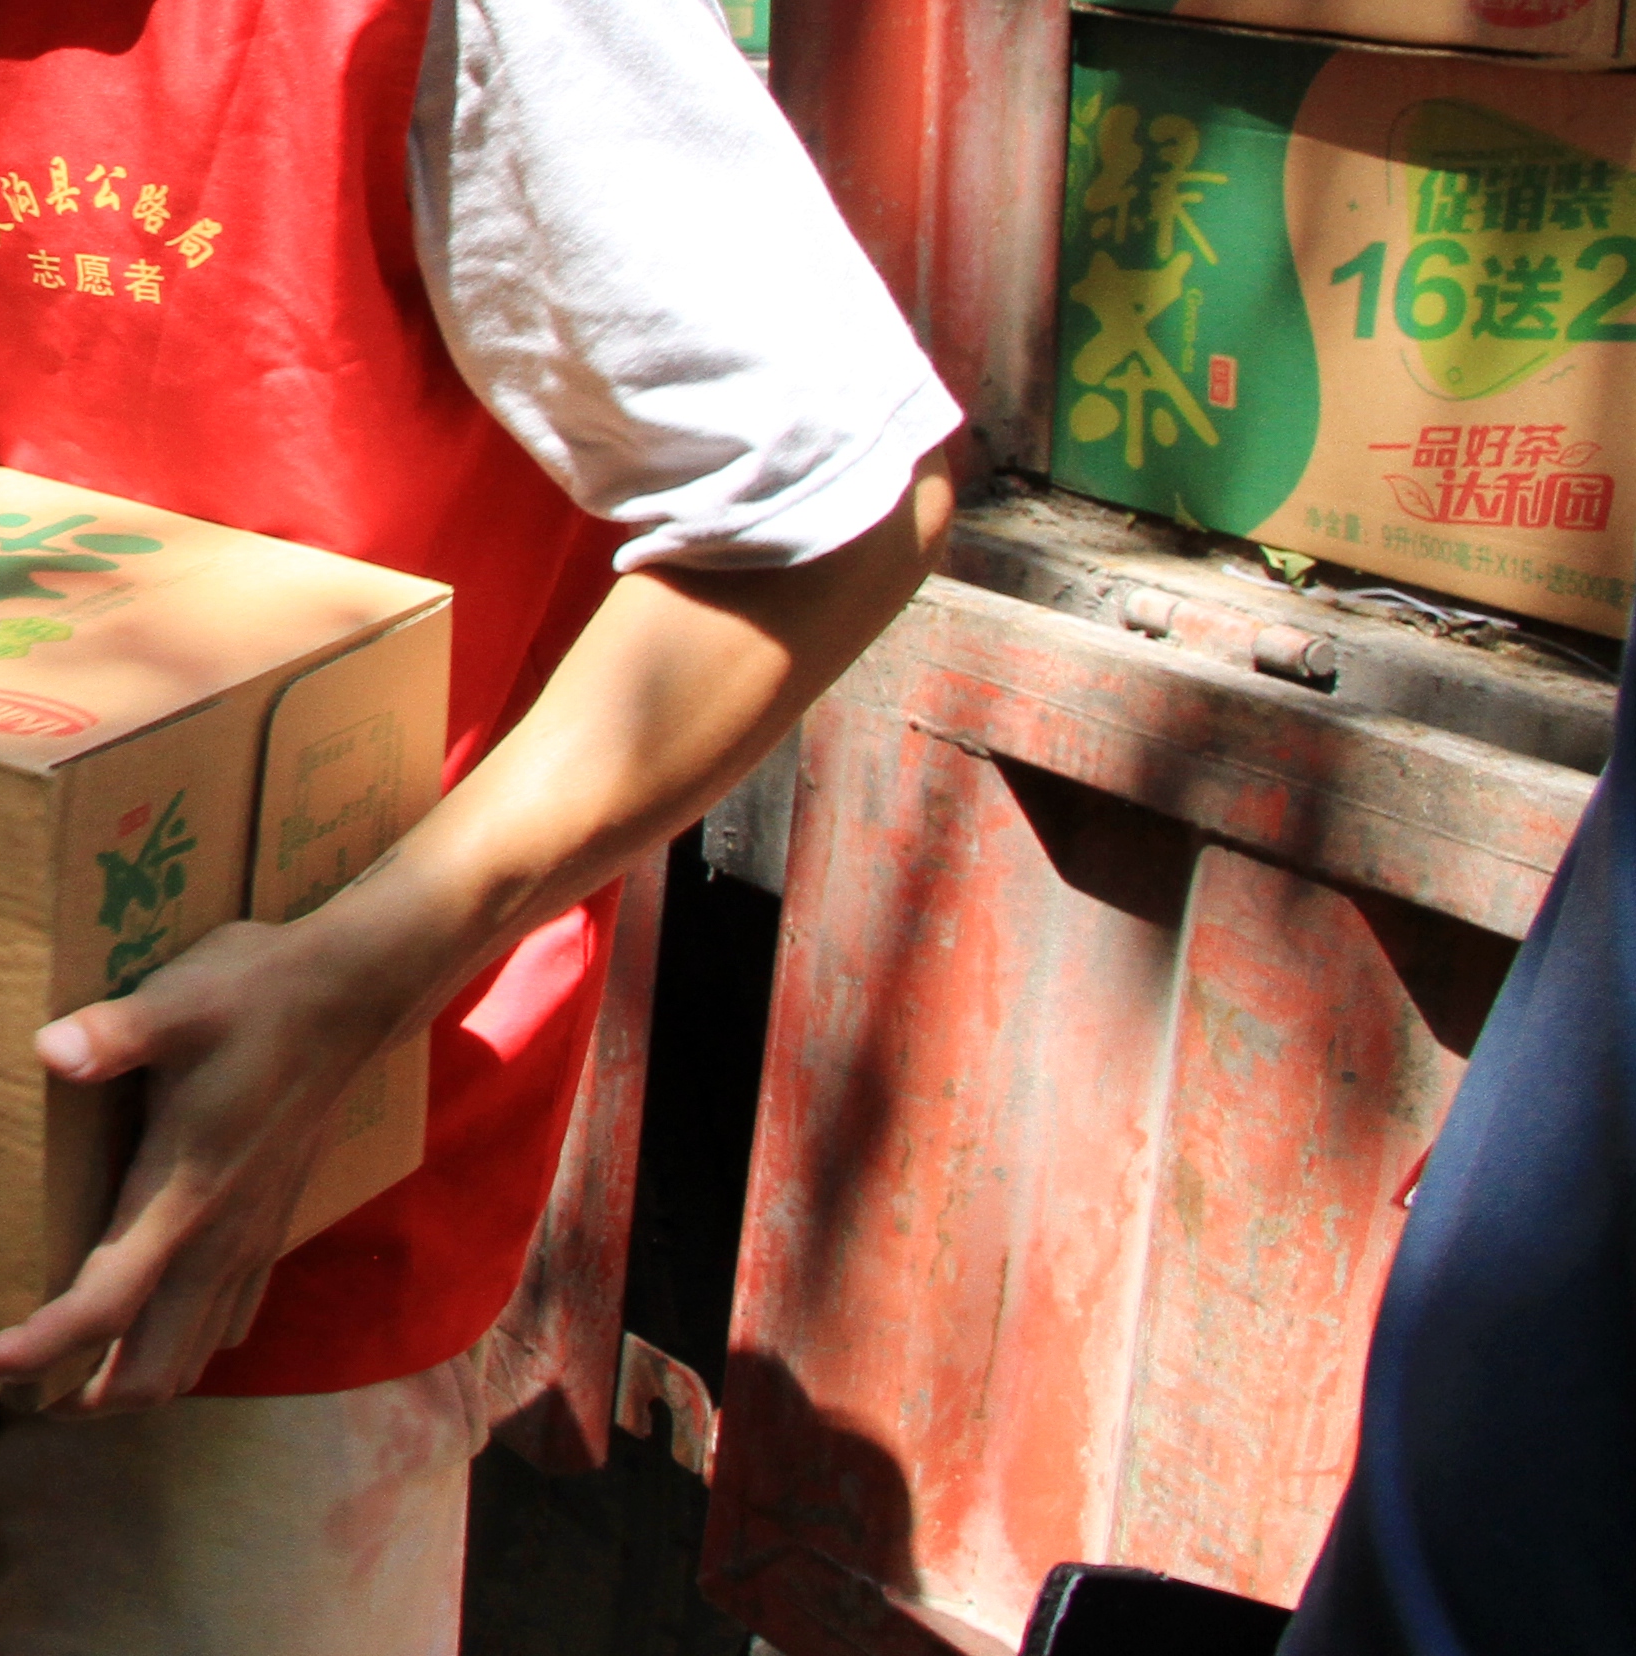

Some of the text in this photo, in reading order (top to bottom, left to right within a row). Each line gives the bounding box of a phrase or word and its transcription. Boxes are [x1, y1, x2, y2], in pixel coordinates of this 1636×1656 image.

[1412, 161, 1615, 234] 促销装
[28, 250, 164, 304] 志愿者
[1070, 104, 1227, 469] 绿茶
[1331, 236, 1636, 342] 16送2
[1369, 424, 1569, 470] 一品好茶
[1434, 470, 1615, 531] 达利园
